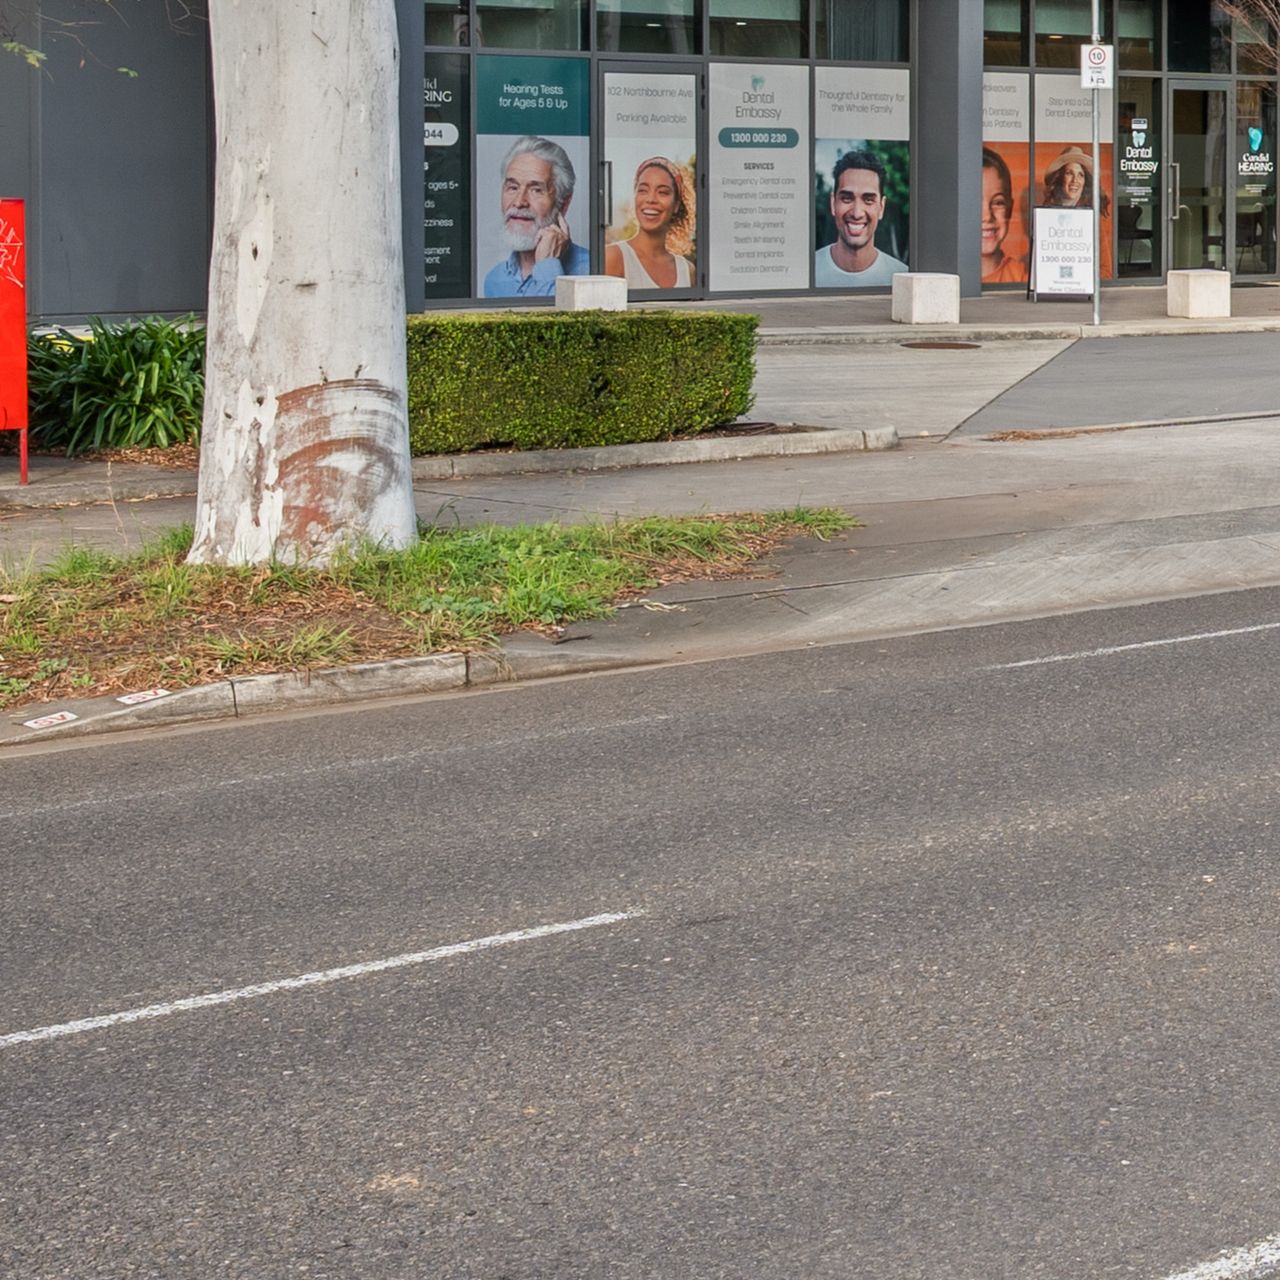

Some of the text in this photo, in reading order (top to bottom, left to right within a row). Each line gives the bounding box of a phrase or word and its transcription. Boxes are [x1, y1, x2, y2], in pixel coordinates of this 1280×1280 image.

[1092, 52, 1102, 60] 10
[503, 84, 564, 96] Hearing Tests
[624, 87, 677, 97] Northbourne
[499, 97, 511, 107] for
[513, 99, 537, 110] Ages
[538, 98, 544, 108] 5
[555, 98, 568, 110] Up
[742, 91, 775, 104] Dental
[735, 106, 782, 121] Embassy
[731, 133, 787, 143] 1300 000 230
[1126, 146, 1152, 158] Dental
[1242, 153, 1269, 162] Candid
[1120, 159, 1158, 173] Embassy
[1238, 162, 1273, 172] HEARING
[1048, 226, 1083, 238] Dental
[1041, 240, 1091, 253] Embassy
